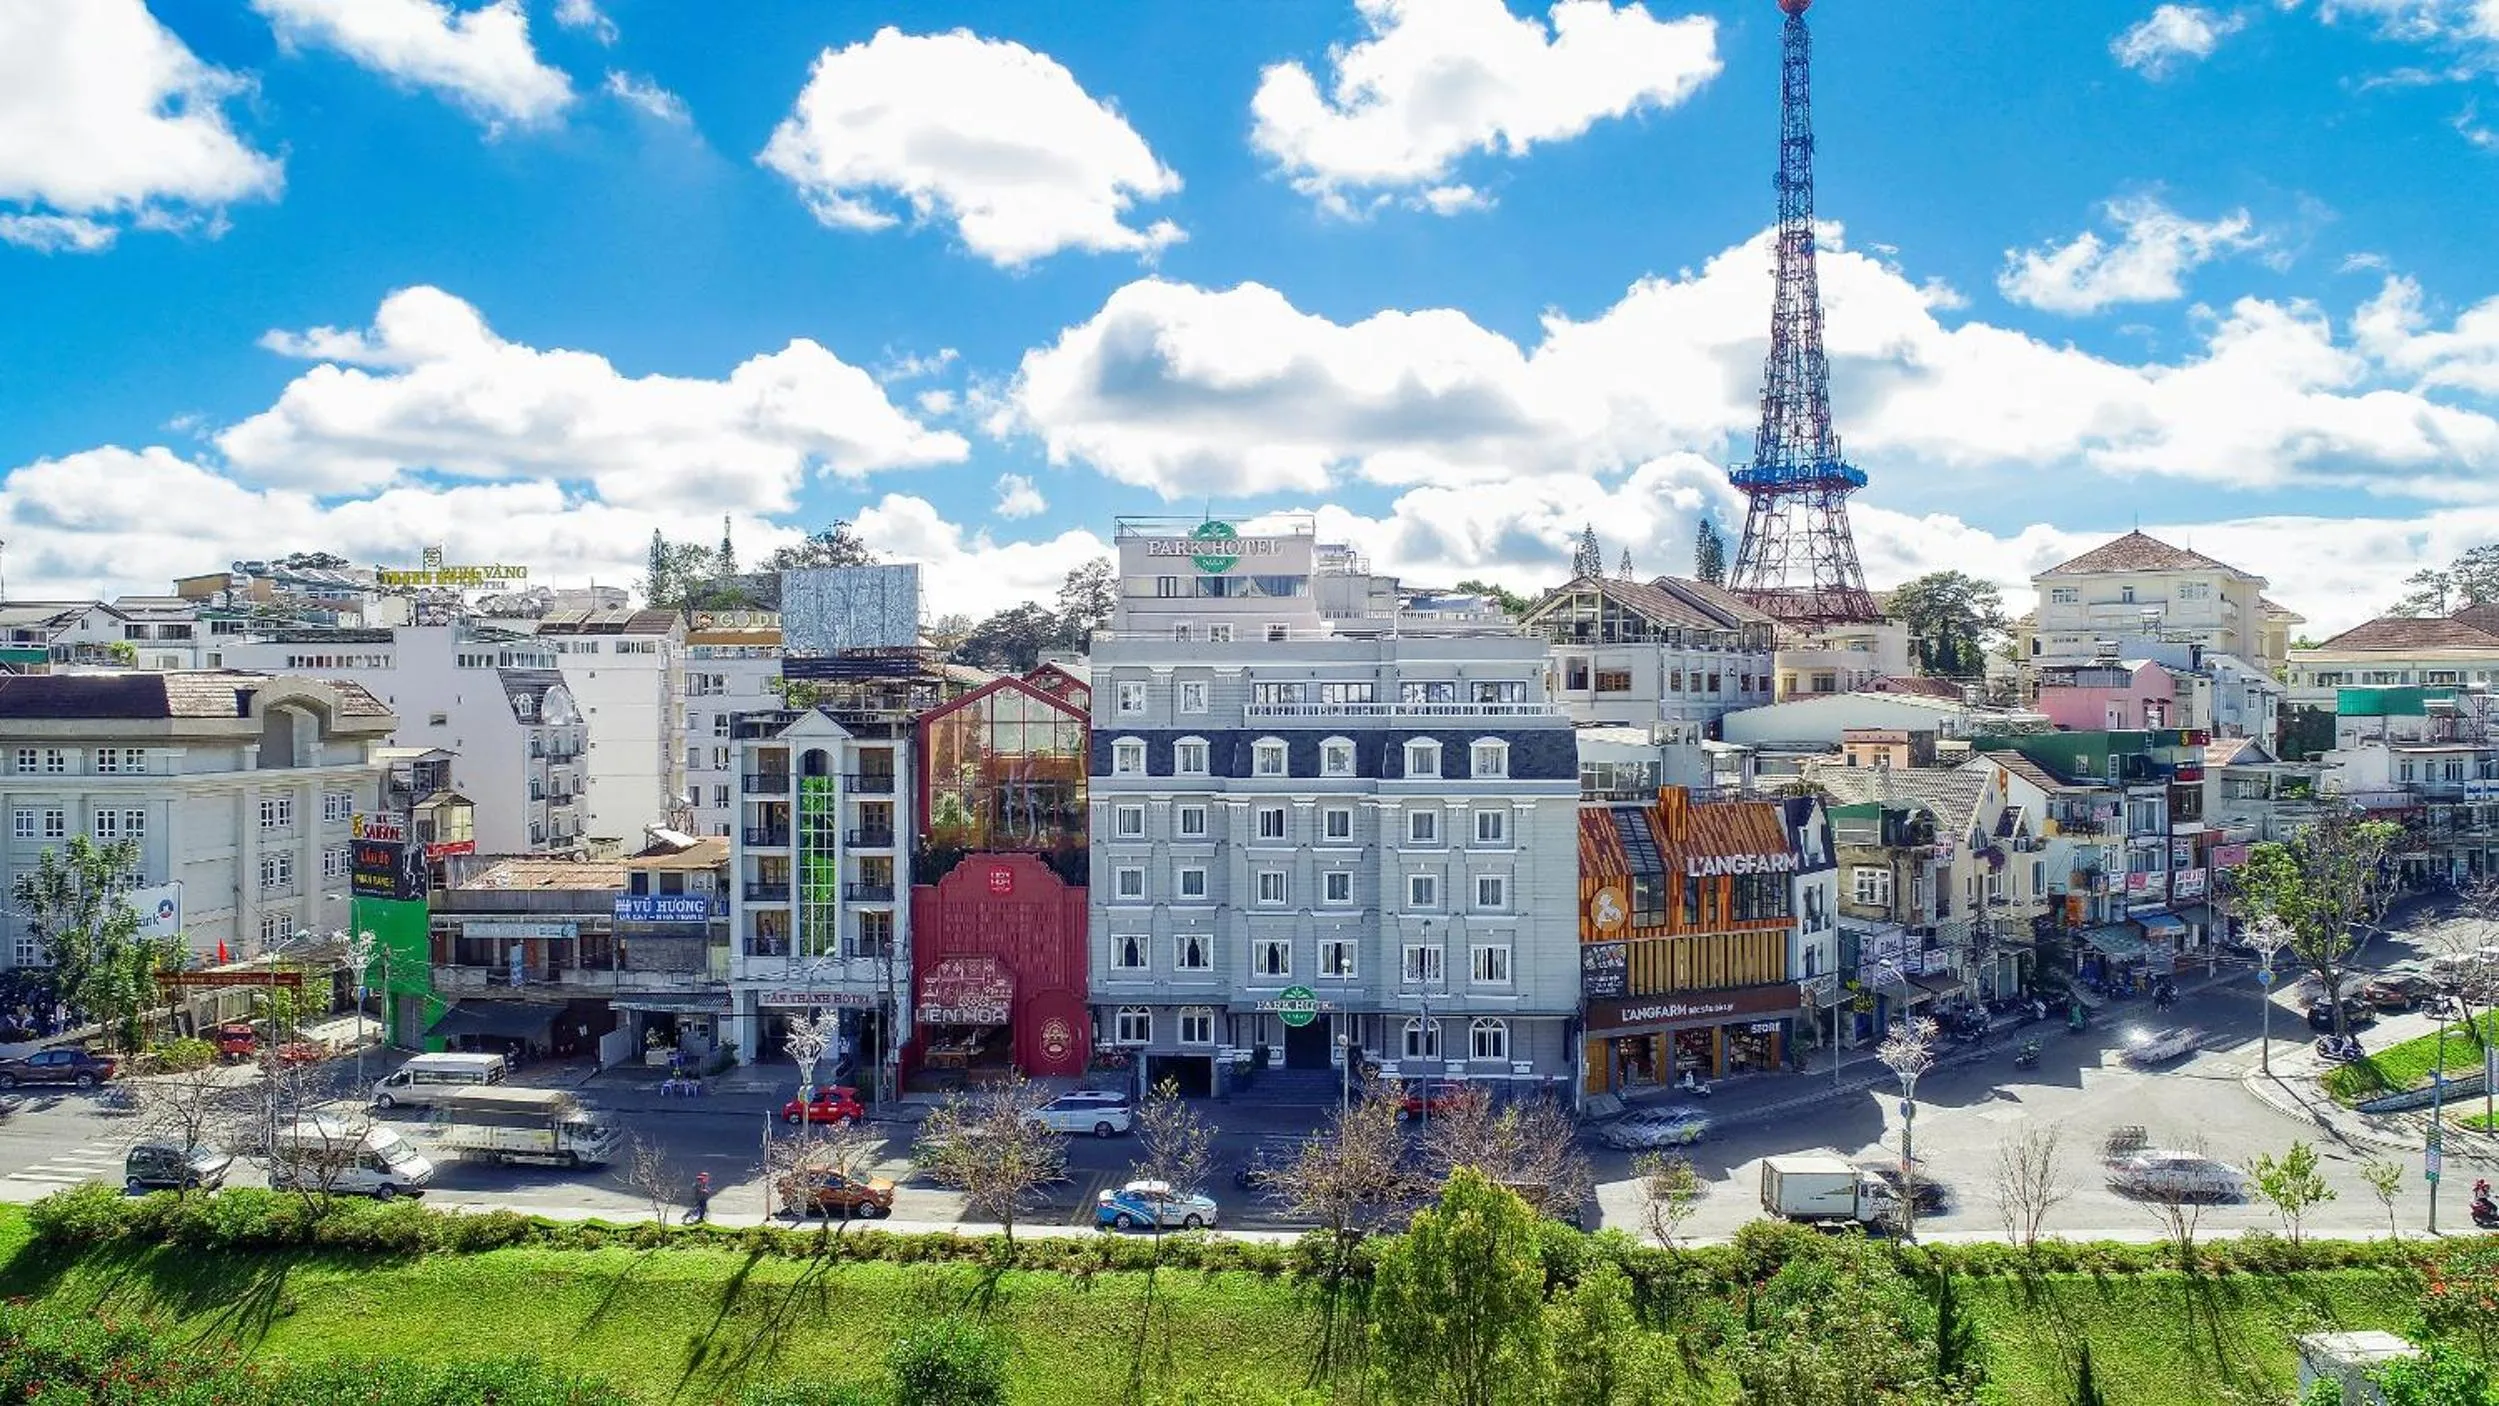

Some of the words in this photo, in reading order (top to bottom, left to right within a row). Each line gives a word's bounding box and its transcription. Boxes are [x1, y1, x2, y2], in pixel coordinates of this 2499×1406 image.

[1148, 541, 1203, 555] PARK
[1211, 540, 1282, 556] HOTEL
[483, 564, 527, 579] VÀNG
[719, 611, 770, 628] GOLD
[1686, 852, 1799, 877] L'ANGFARM
[633, 897, 652, 912] VŨ
[656, 898, 705, 913] HƯƠNG
[1256, 1000, 1290, 1011] PARK
[1622, 1003, 1687, 1021] L'ANGFARM
